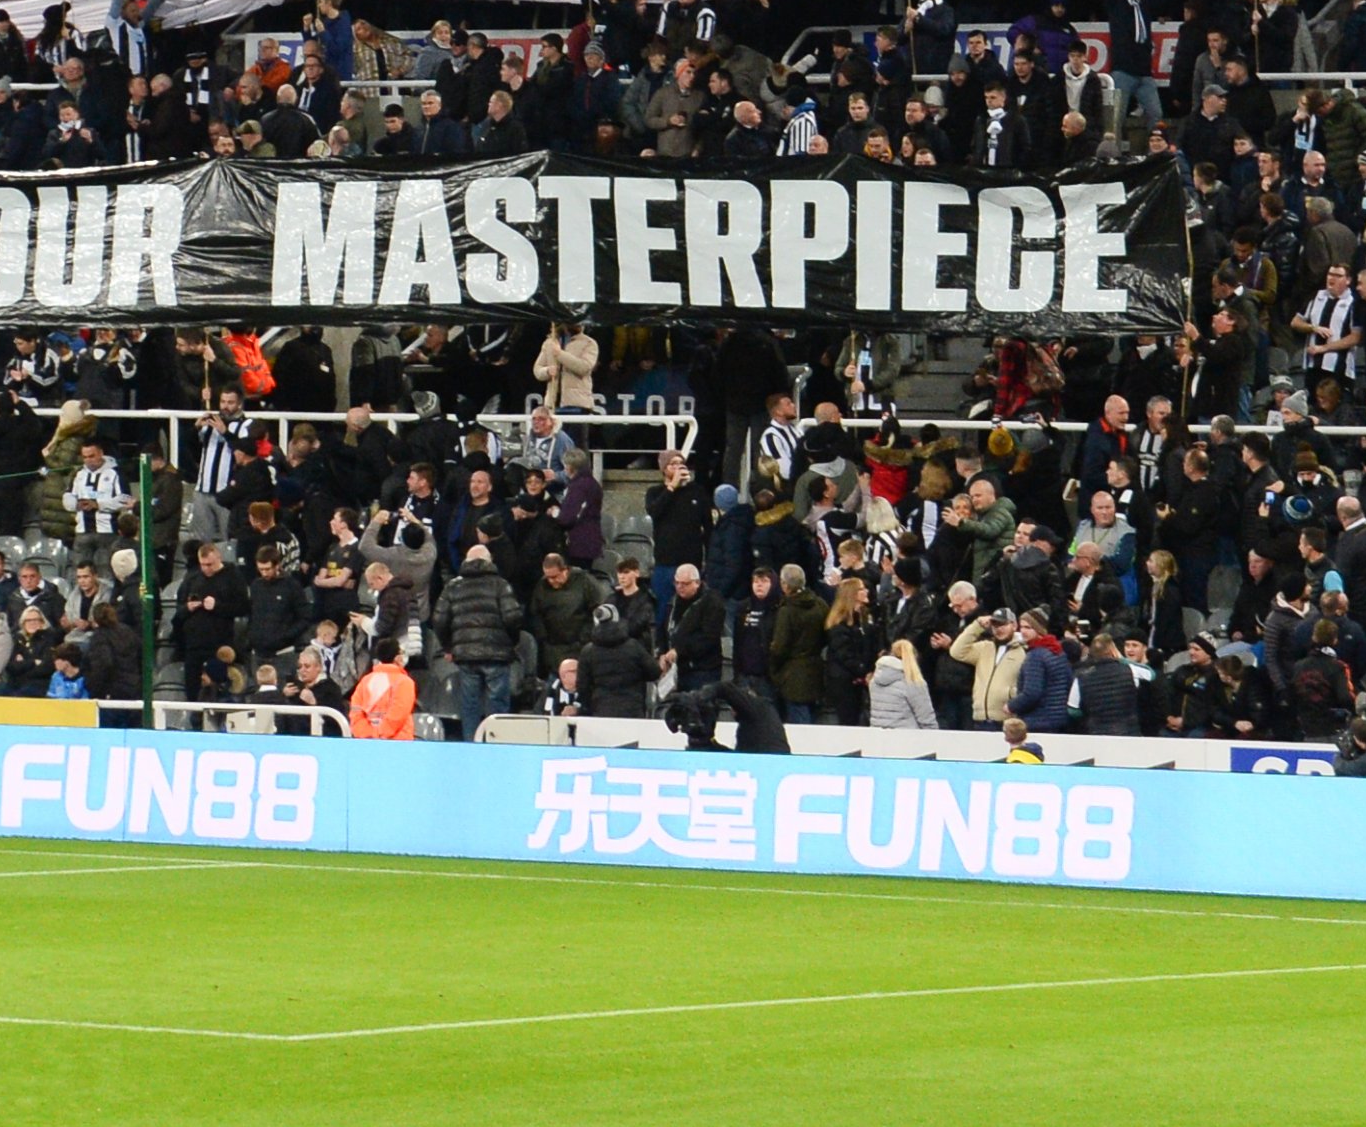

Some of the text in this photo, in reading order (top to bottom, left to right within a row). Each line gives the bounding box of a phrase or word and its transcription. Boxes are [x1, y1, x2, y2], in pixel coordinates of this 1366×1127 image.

[271, 174, 1129, 313] MASTERPIECE
[525, 393, 696, 426] CSTOR
[0, 743, 317, 842] FUN88
[527, 755, 1134, 881] 乐天堂 FUN88
